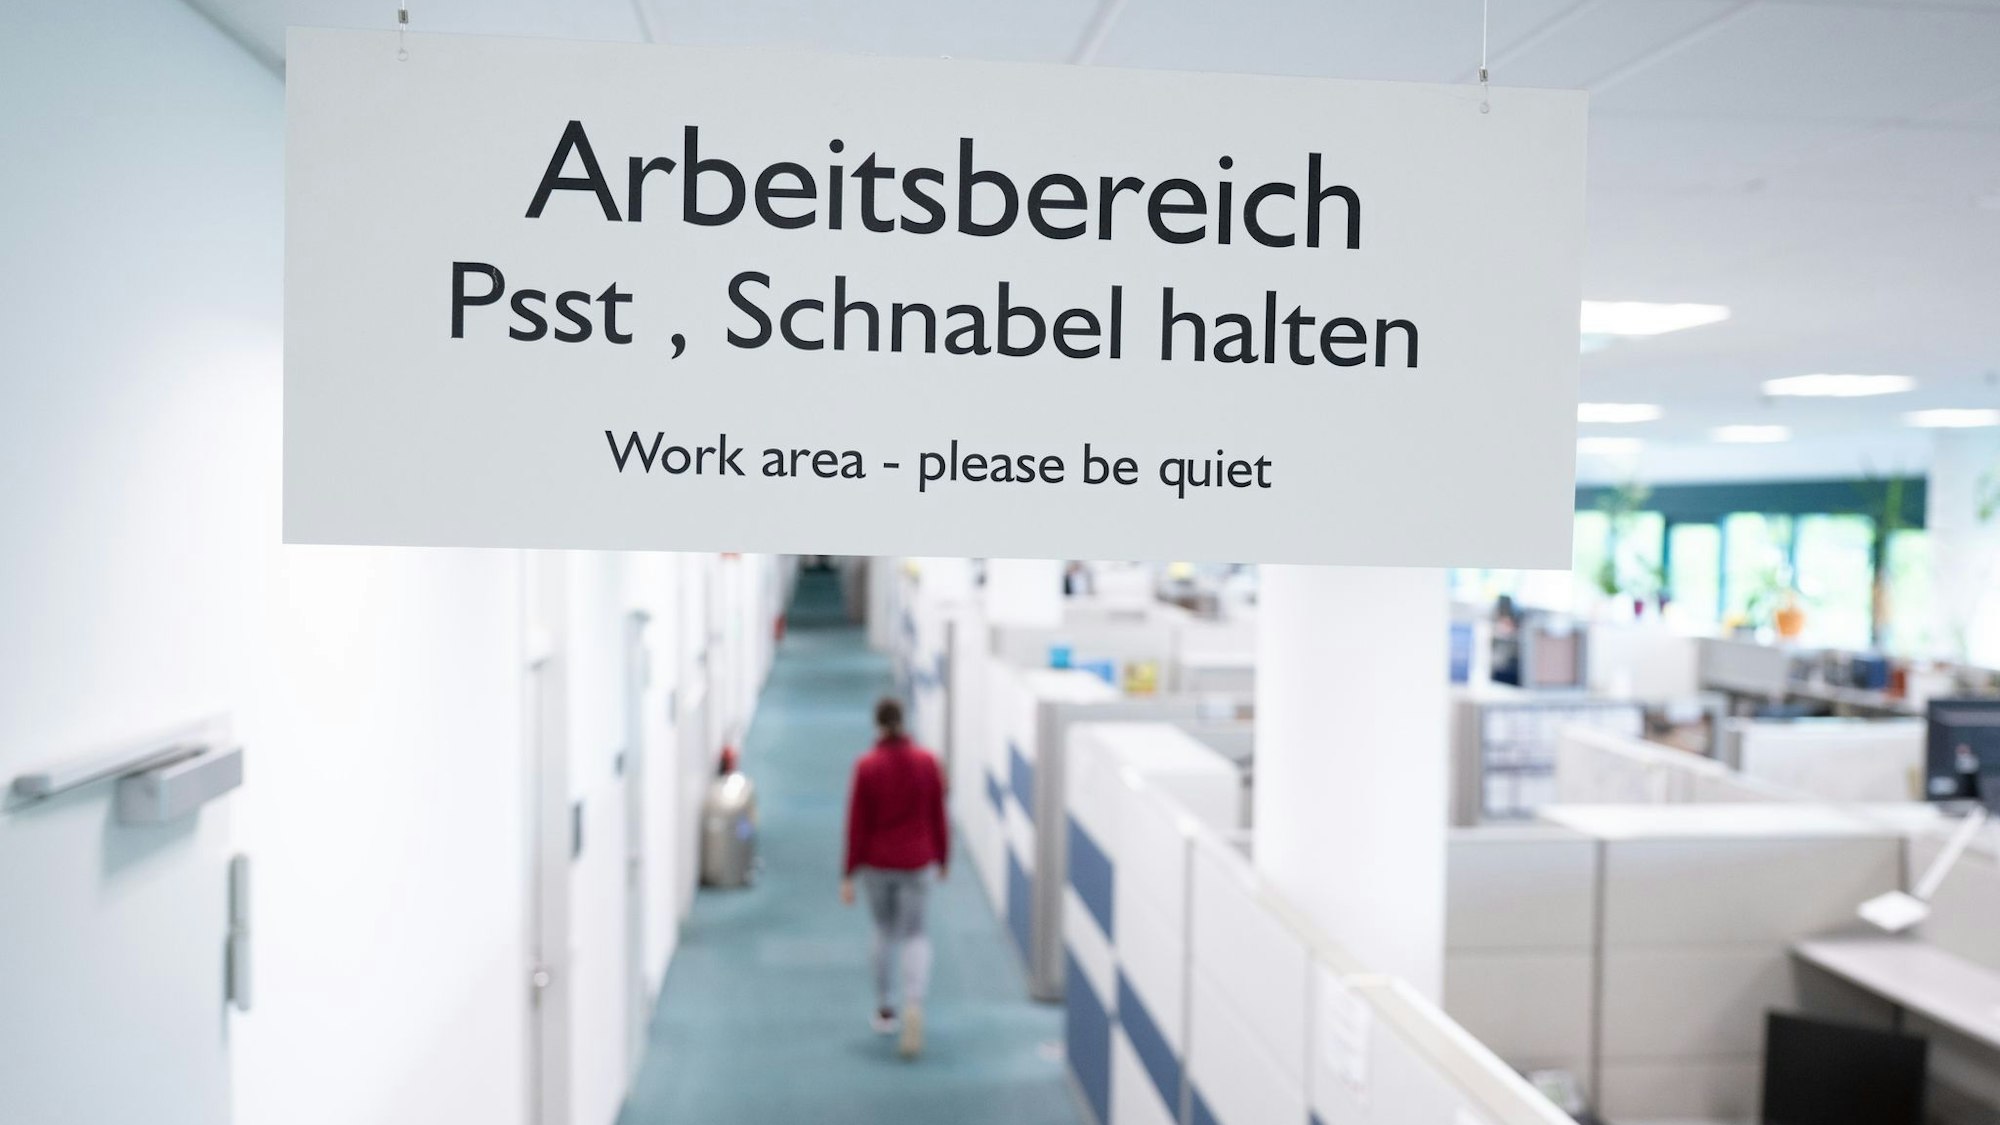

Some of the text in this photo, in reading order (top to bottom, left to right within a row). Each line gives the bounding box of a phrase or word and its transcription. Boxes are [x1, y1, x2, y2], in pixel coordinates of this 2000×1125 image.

[525, 119, 1361, 250] Arbeitsbereich
[450, 261, 1419, 369] Psst , Schnabel halten
[604, 430, 746, 477] Work
[761, 448, 867, 482] area
[919, 439, 1065, 493] please
[1083, 442, 1139, 486] be
[1159, 449, 1272, 500] quiet
